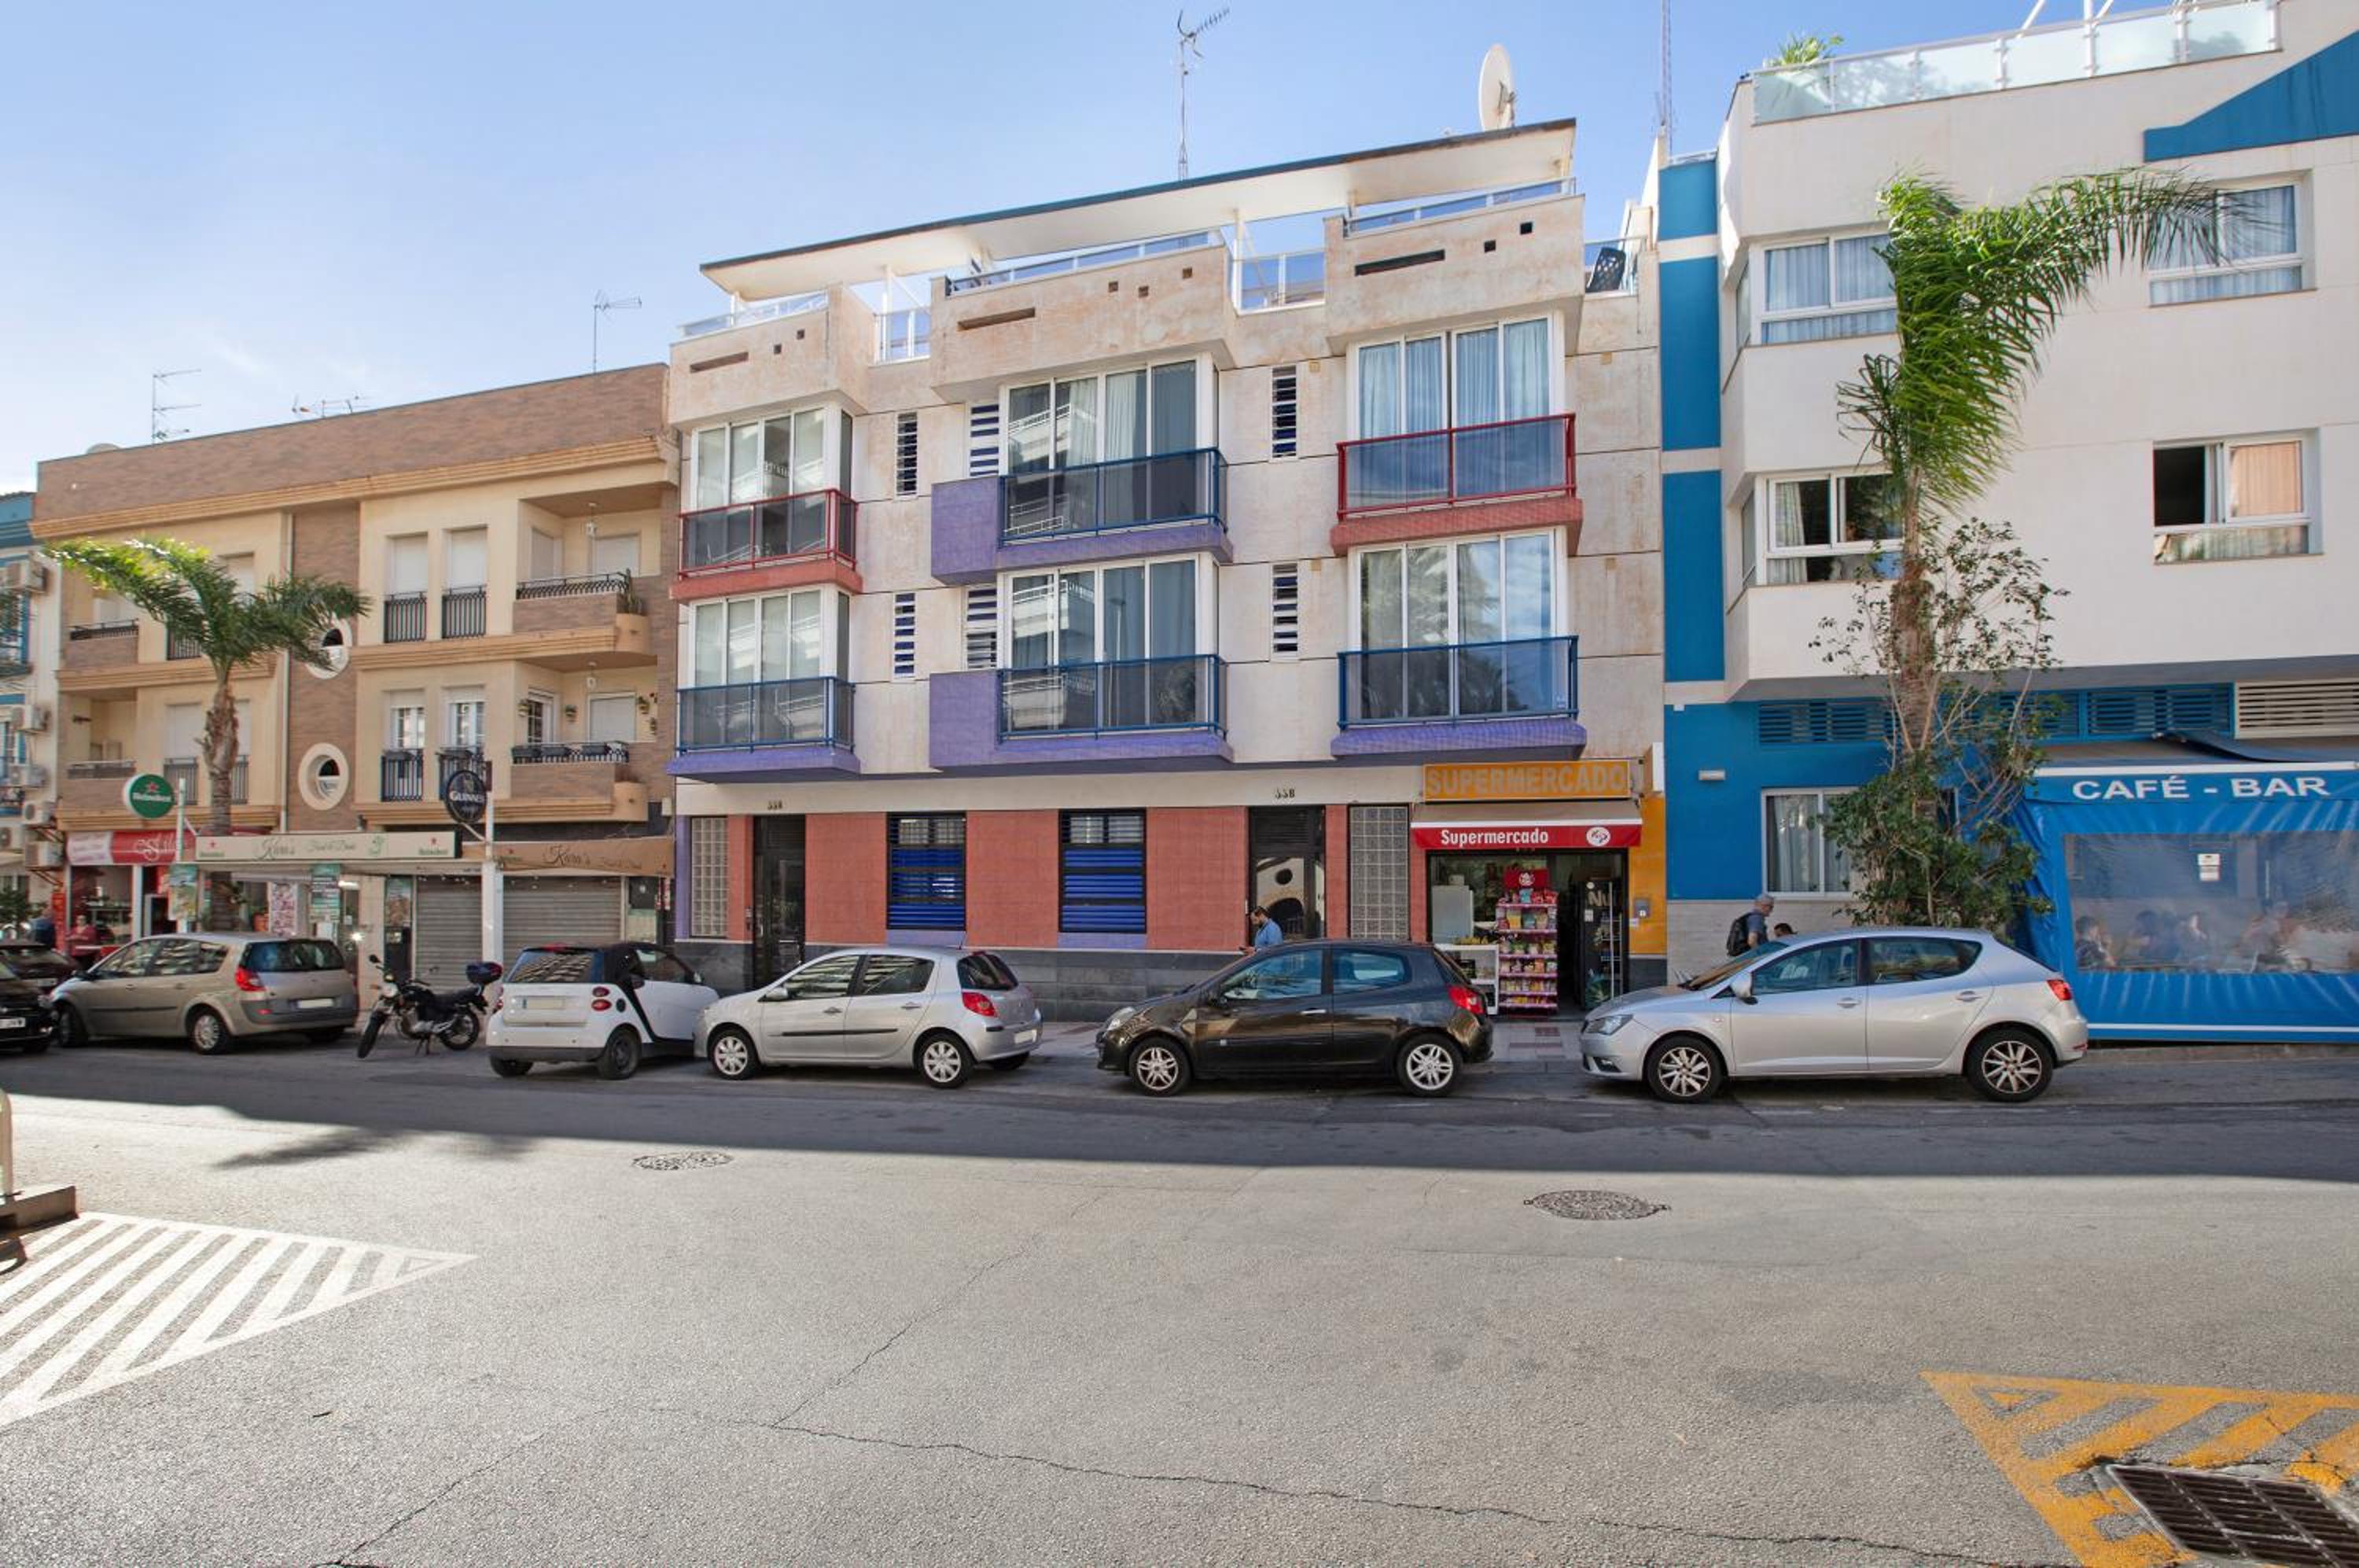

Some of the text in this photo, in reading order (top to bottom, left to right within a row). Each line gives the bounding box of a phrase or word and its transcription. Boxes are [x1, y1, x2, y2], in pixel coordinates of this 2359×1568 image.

[1427, 764, 1625, 796] SUPERMERCADO
[2072, 775, 2190, 800] CAFÉ
[2230, 777, 2331, 797] BAR
[1441, 828, 1549, 847] Supermercado
